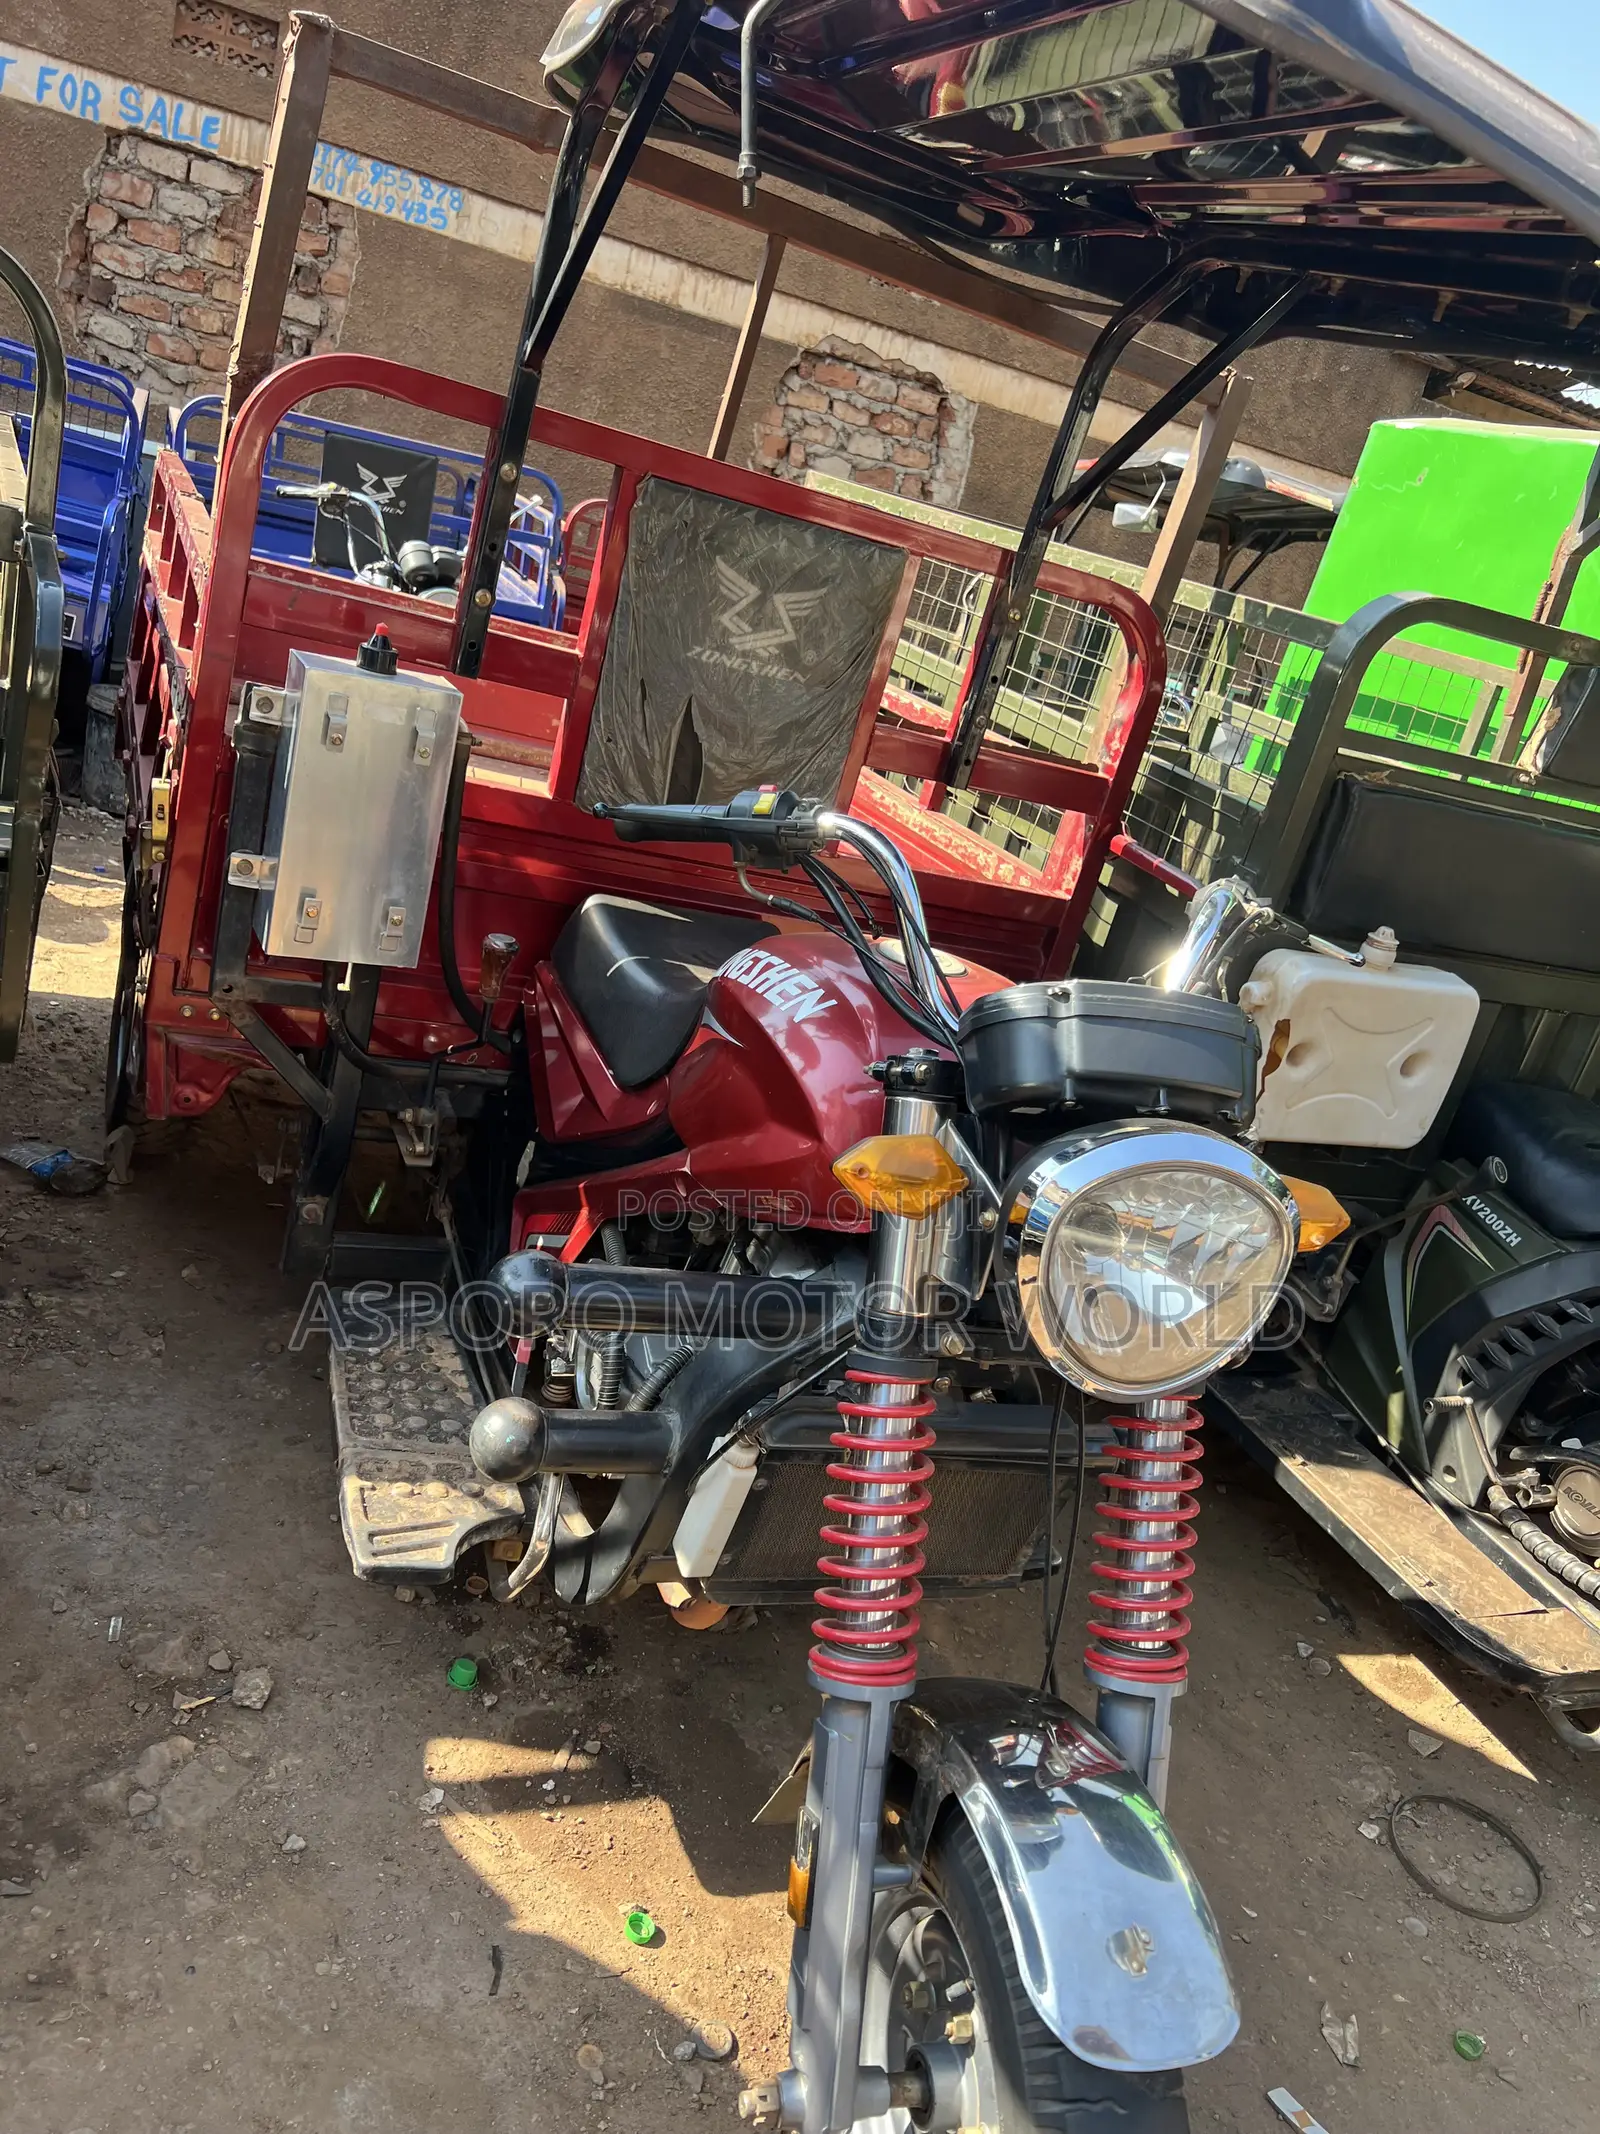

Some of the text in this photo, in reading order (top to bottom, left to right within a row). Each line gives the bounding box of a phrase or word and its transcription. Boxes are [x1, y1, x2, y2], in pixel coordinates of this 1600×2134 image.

[36, 66, 102, 123] FOR
[119, 84, 221, 150] SALE
[356, 188, 396, 215] 419
[369, 161, 413, 192] 955
[419, 175, 464, 212] 878
